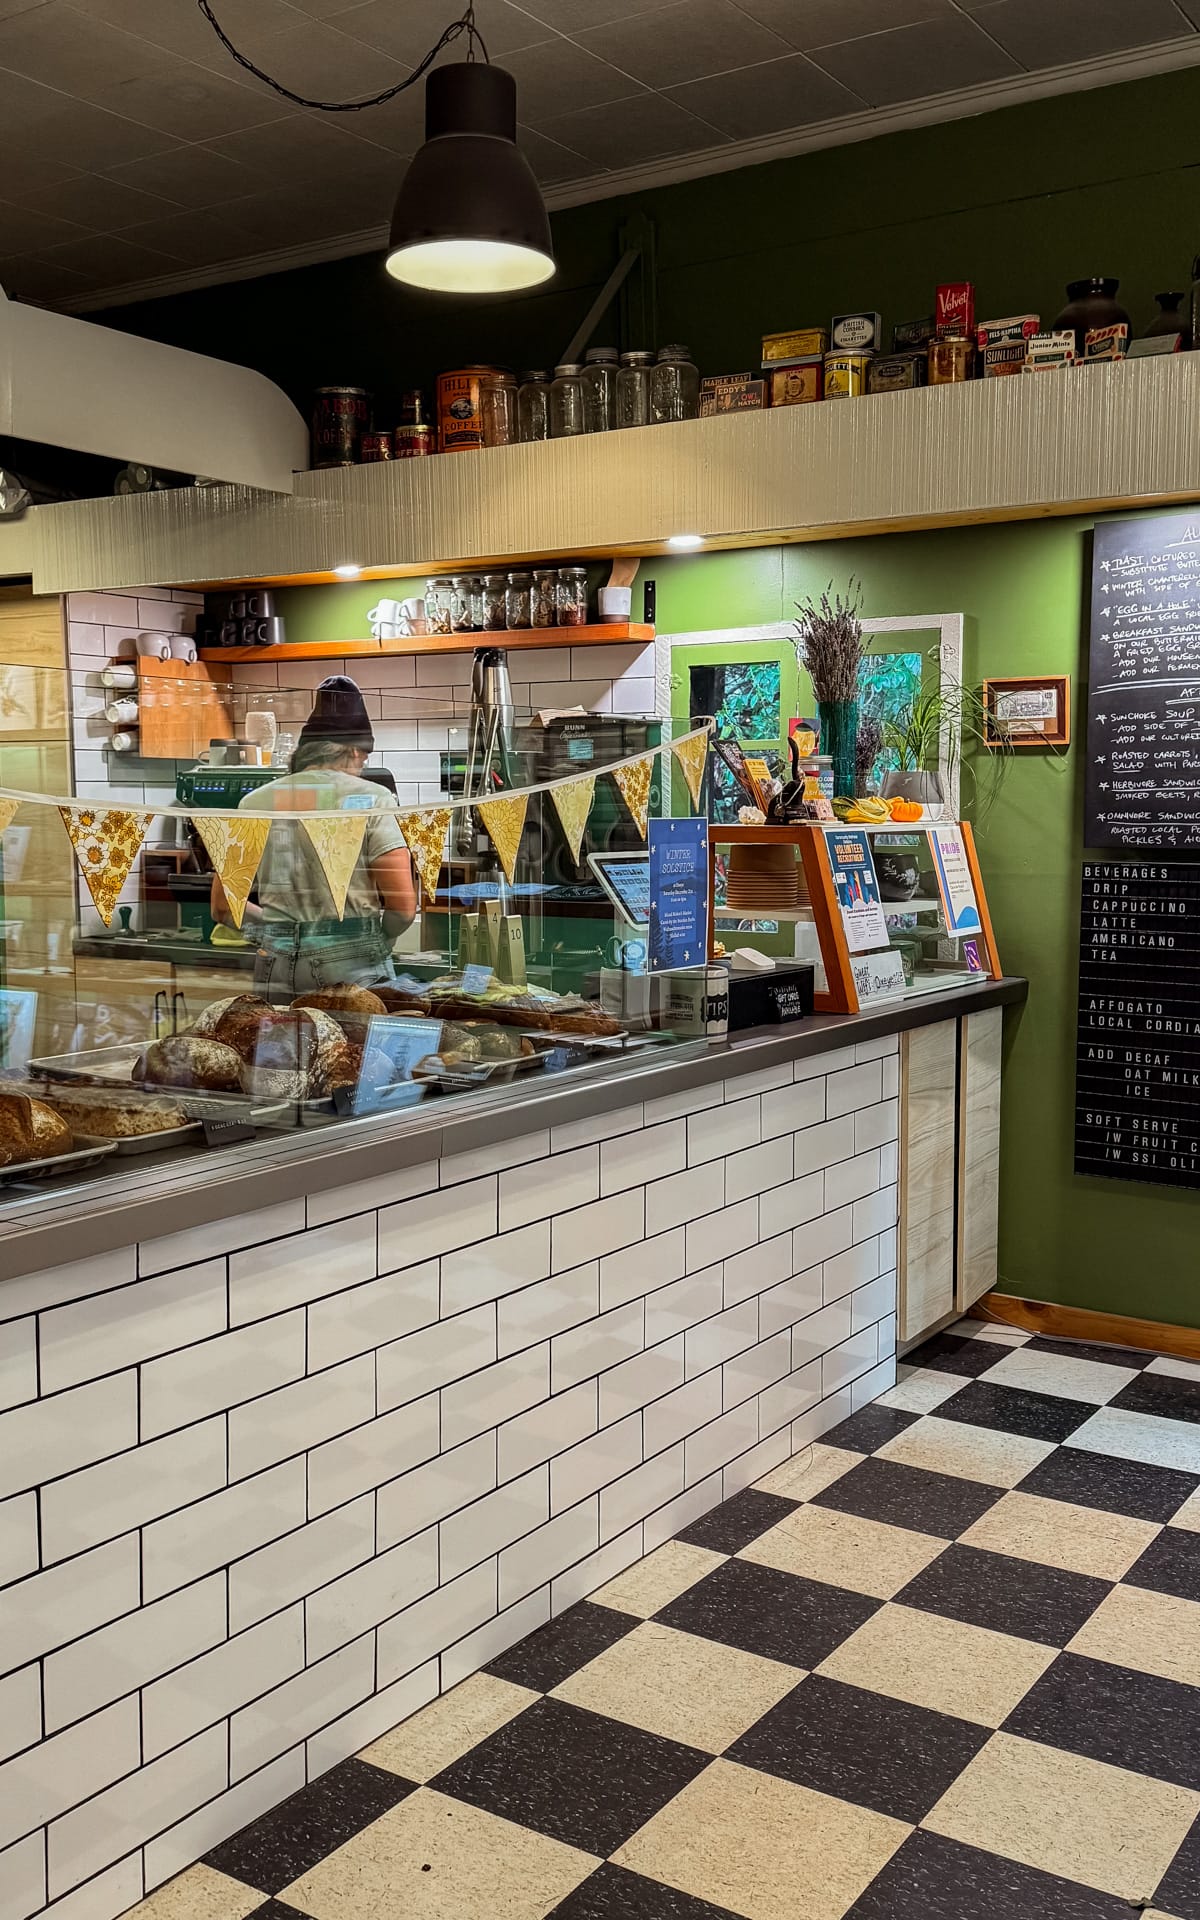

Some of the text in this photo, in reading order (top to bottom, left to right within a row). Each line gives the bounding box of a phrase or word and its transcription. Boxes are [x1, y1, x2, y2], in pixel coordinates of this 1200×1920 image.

[938, 289, 967, 313] Velvet
[1030, 340, 1070, 350] Junior Mints
[986, 346, 1024, 364] SUNLIGHT
[718, 384, 747, 395] EDDY'S
[1151, 551, 1196, 564] CULTURED
[1112, 580, 1144, 591] WINTER
[1125, 587, 1146, 597] WITH
[1179, 581, 1191, 589] OF
[1128, 615, 1155, 624] LOCAL
[1158, 612, 1180, 621] EGG
[1112, 627, 1164, 639] BREAKFAST
[1113, 650, 1121, 658] A
[1127, 647, 1154, 657] FRIED
[1143, 656, 1160, 664] OUR
[1142, 665, 1160, 674] OUR
[1110, 707, 1195, 722] SUNCHOKE SOUP
[1143, 723, 1167, 731] SIDE
[1111, 751, 1150, 761] ROASTED
[1112, 761, 1144, 770] SALAD
[1154, 761, 1177, 769] WITH
[1112, 780, 1157, 790] HERBIVORE
[1115, 792, 1149, 801] SMOKED
[1107, 811, 1152, 820] OMNIVORE
[1110, 826, 1147, 834] ROASTED
[1122, 835, 1162, 845] PICKLES
[666, 849, 691, 860] WINTER
[661, 861, 695, 874] SOLSTICE
[1084, 867, 1168, 879] BEVERAGES
[1093, 883, 1128, 895] DRIP
[1093, 900, 1186, 913] CAPPUCCINO
[492, 912, 498, 924] 4
[1093, 917, 1136, 929] LATTE
[511, 928, 522, 940] 10
[1091, 934, 1175, 948] AMERICANO
[1091, 949, 1117, 961] TEA
[706, 1001, 728, 1016] TIPS
[1090, 1000, 1162, 1014] AFFOGATO
[1090, 1016, 1133, 1029] LOCAL
[1088, 1048, 1170, 1065] ADD DECAF
[1125, 1068, 1200, 1086] OAT MILK
[1126, 1085, 1150, 1097] ICE
[1086, 1114, 1178, 1134] SOFT SERVE
[1133, 1136, 1178, 1150] FRUIT
[1132, 1152, 1156, 1165] SSI
